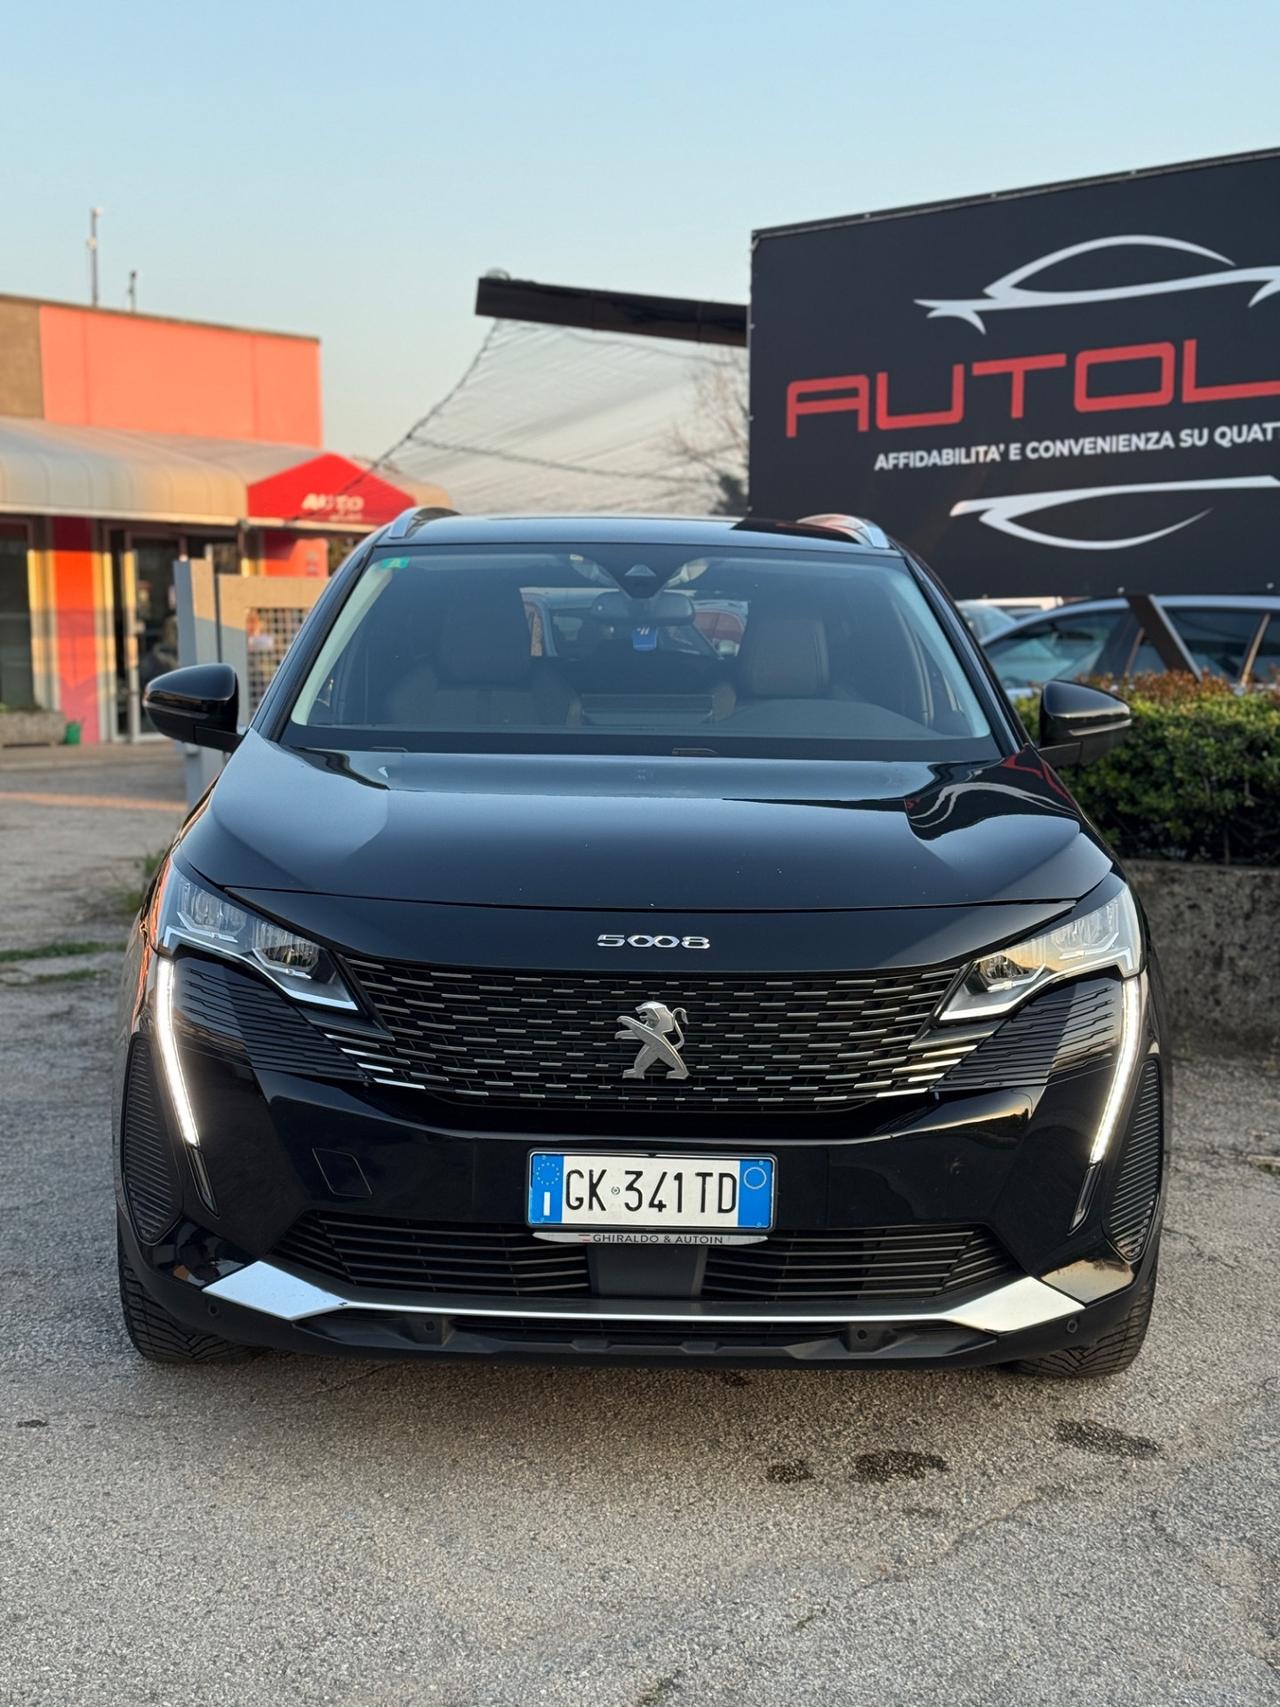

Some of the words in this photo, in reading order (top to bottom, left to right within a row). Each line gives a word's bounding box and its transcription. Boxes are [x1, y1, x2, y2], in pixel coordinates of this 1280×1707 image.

[874, 445, 1005, 471] AFFIDABILITA'
[1009, 443, 1022, 461] E
[1027, 431, 1175, 461] CONVENIENZA
[1180, 428, 1209, 448] SU
[1214, 421, 1280, 448] QUAT
[597, 934, 710, 949] 5008
[565, 1169, 607, 1211] GK
[592, 1234, 659, 1244] GHIRALDO
[663, 1235, 671, 1244] &
[675, 1236, 723, 1245] AUTOIN
